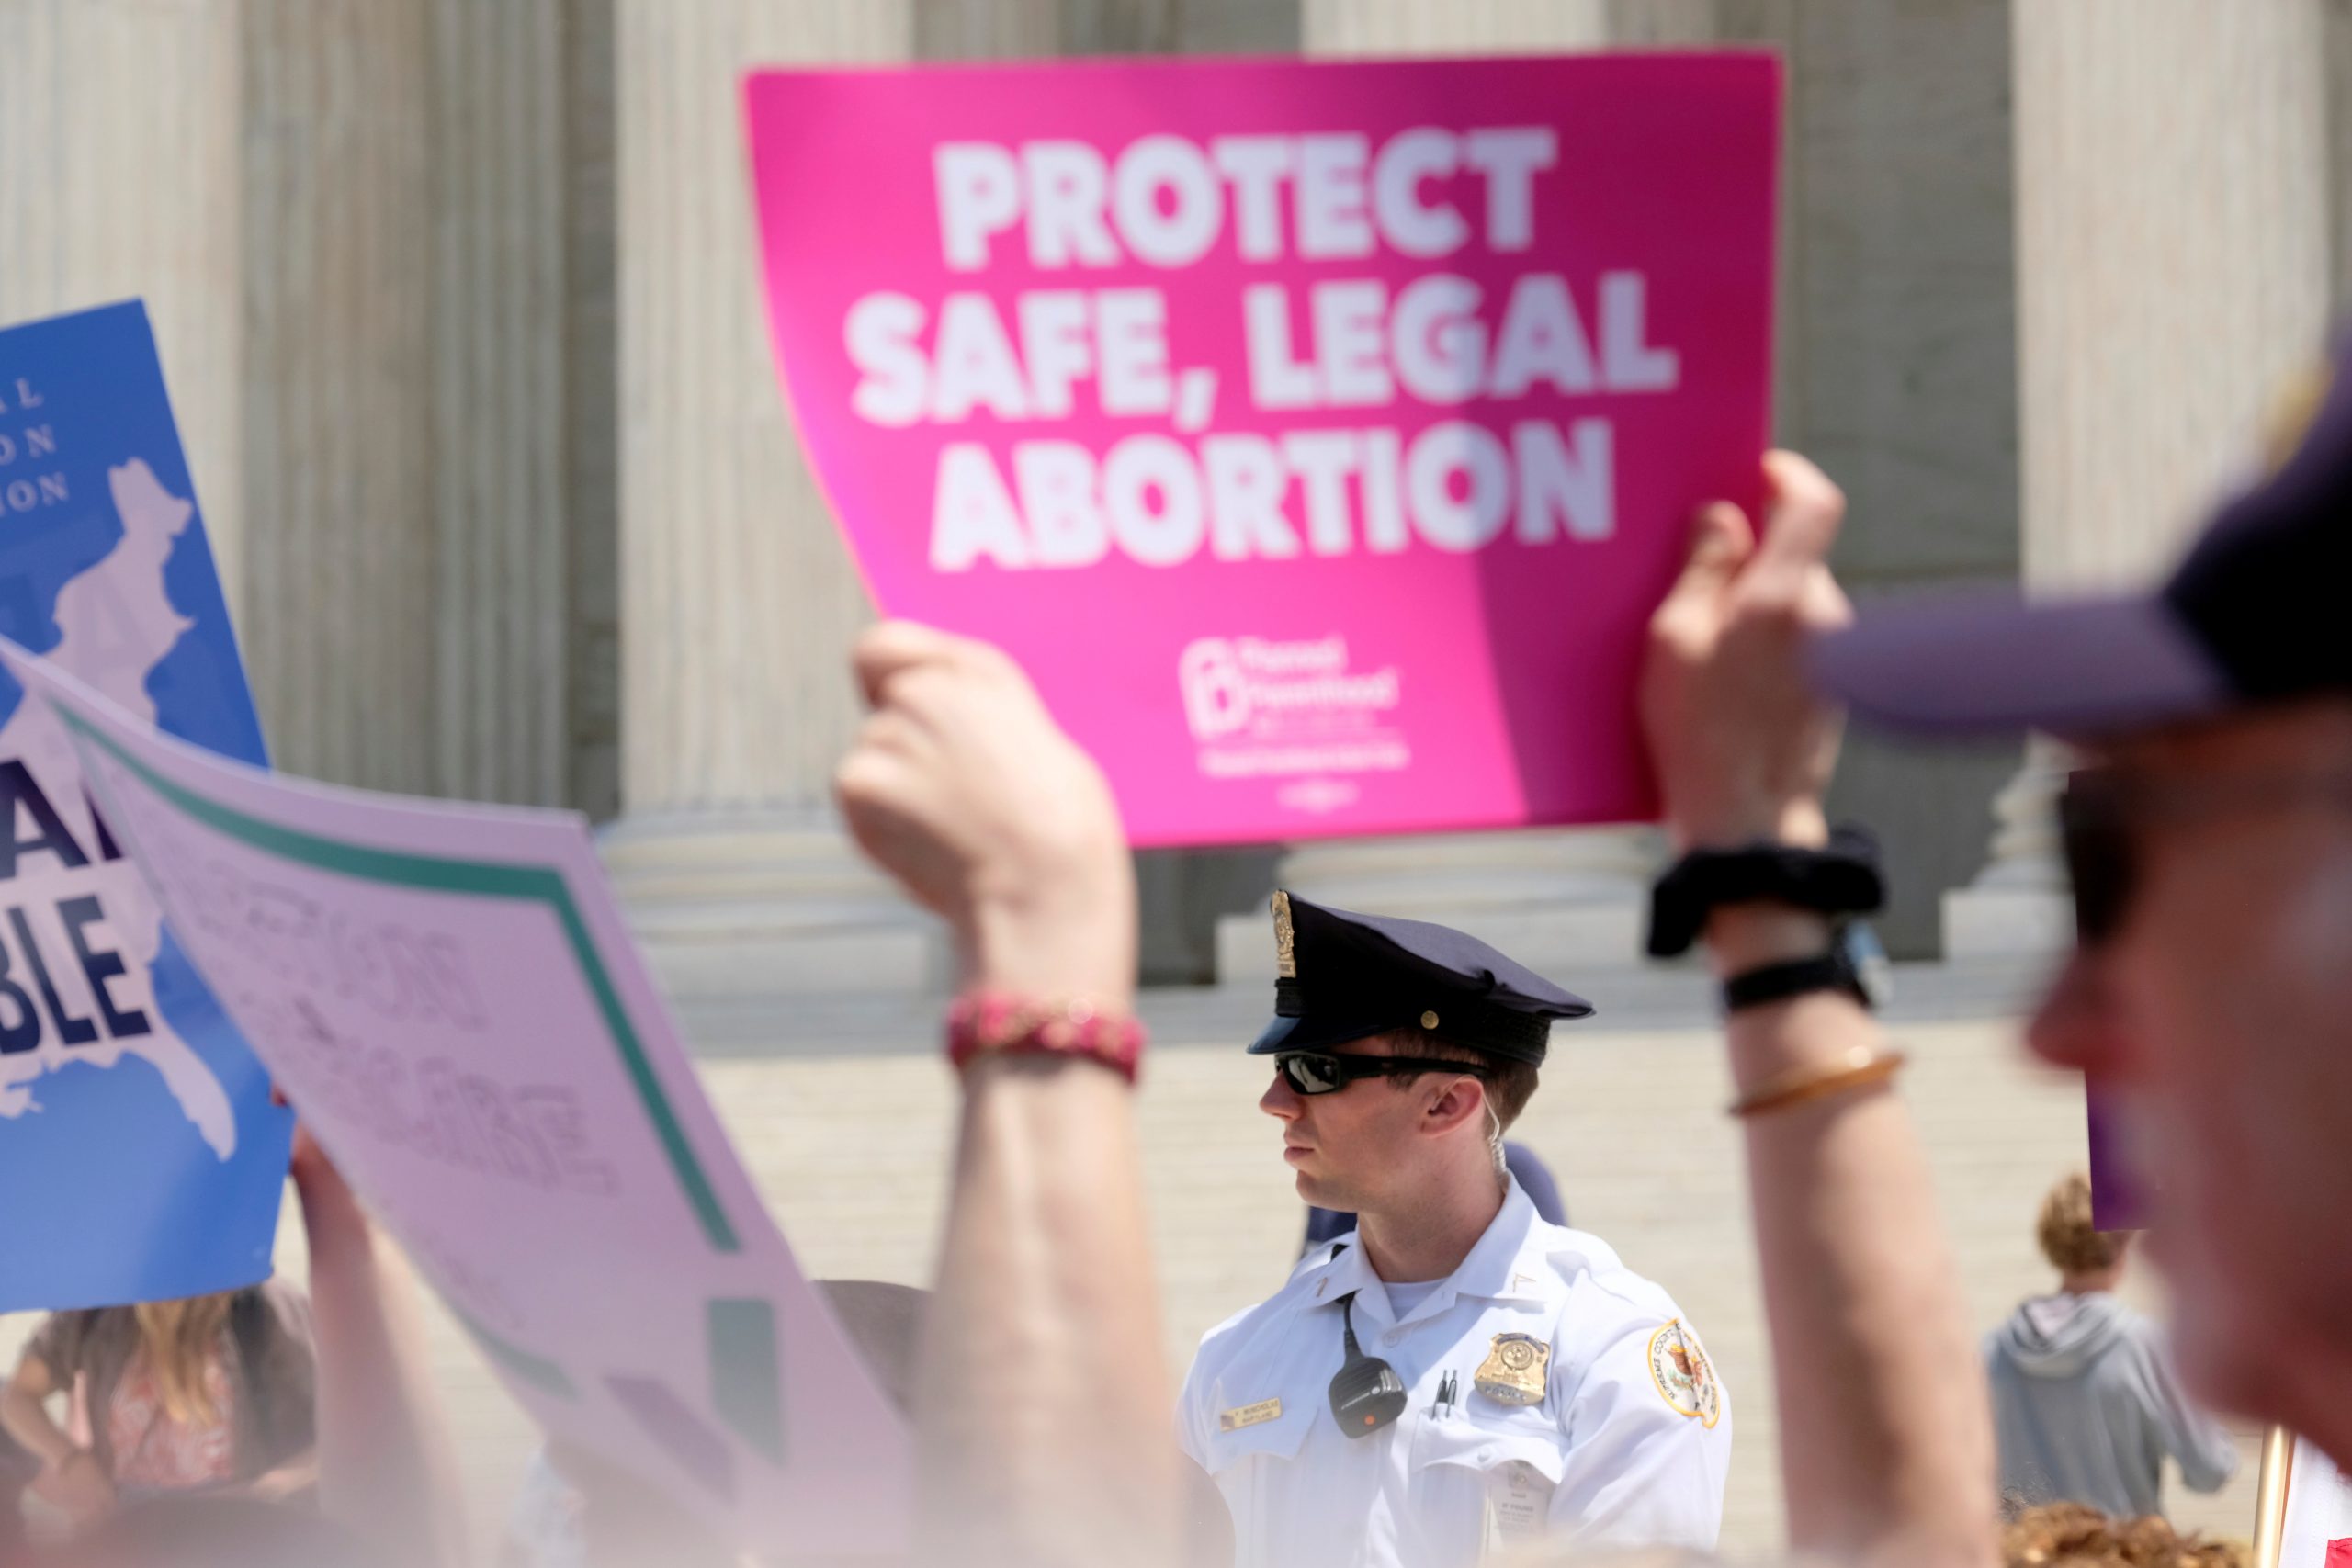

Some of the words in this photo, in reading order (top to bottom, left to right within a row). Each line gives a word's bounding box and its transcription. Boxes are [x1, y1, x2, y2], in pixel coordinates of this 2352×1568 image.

[933, 128, 1556, 270] PROTECT
[0, 378, 44, 412] L
[843, 288, 1216, 432] SAFE,
[1244, 273, 1677, 409] LEGAL
[929, 421, 1613, 571] ABORTION
